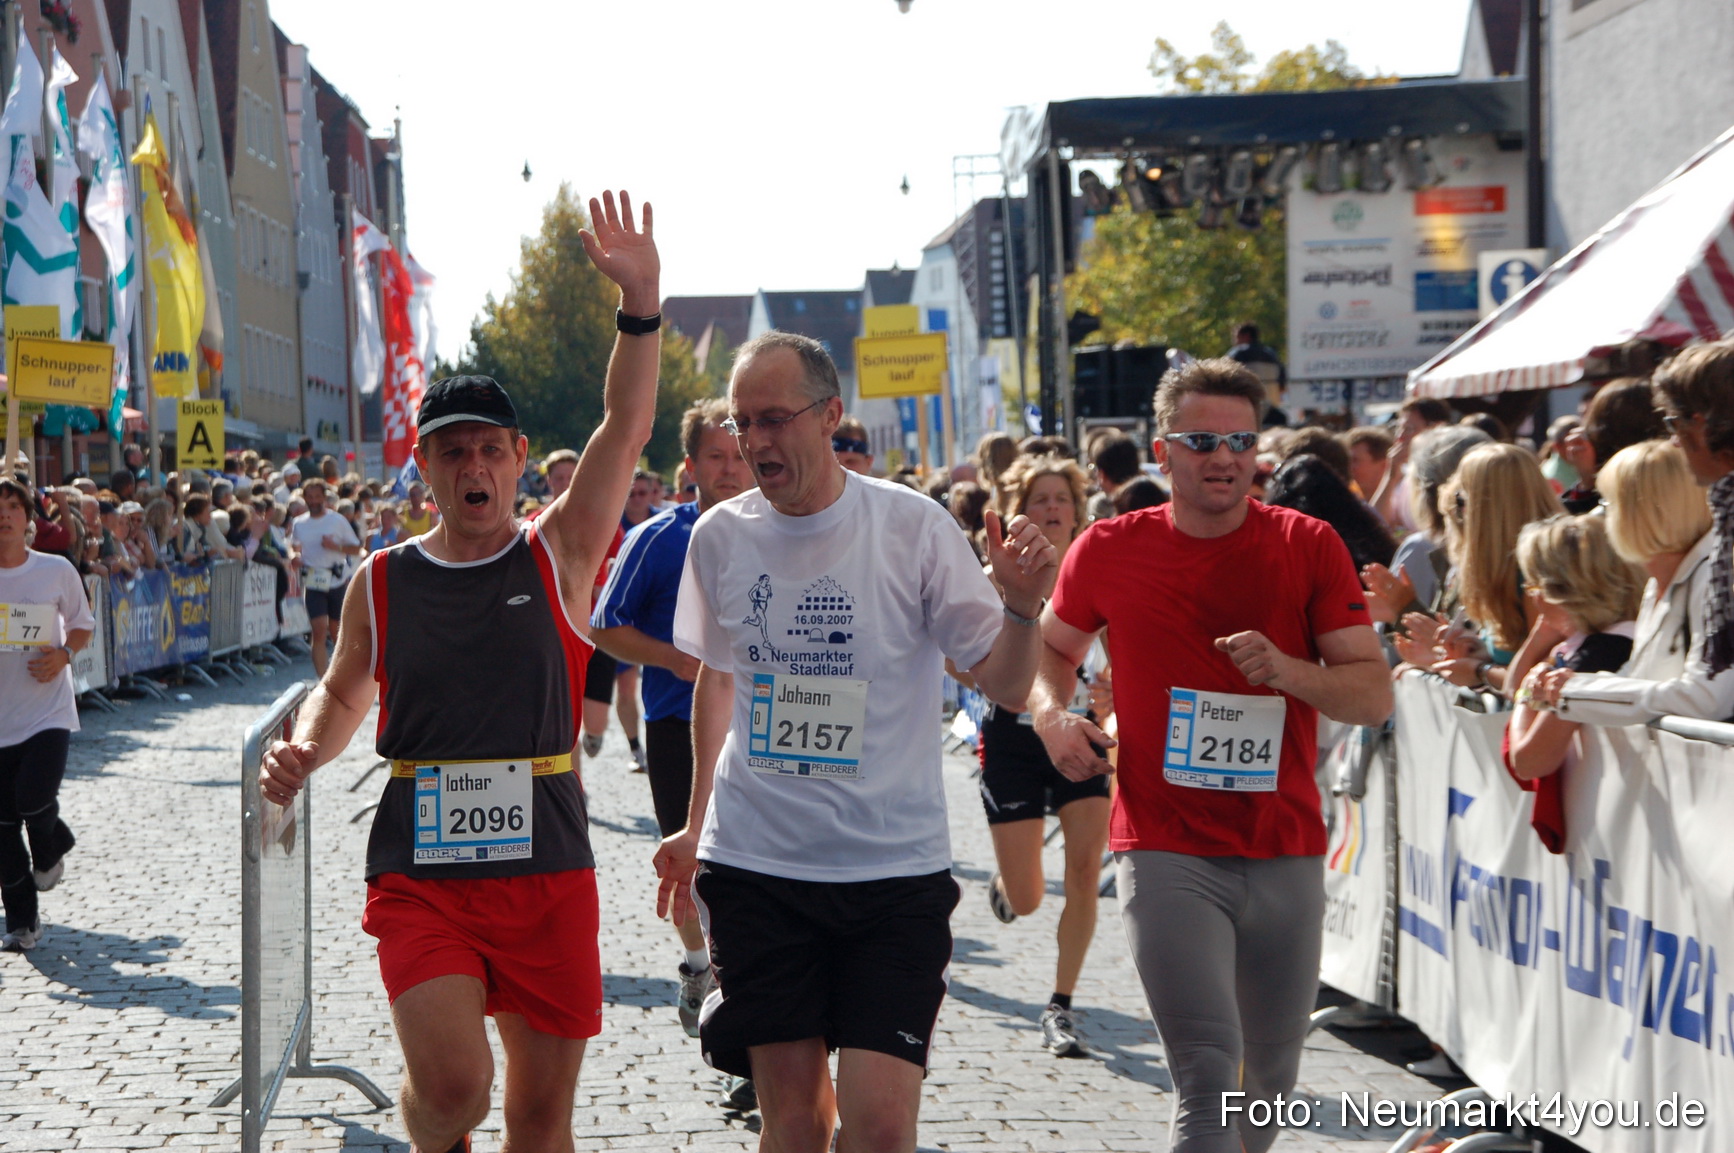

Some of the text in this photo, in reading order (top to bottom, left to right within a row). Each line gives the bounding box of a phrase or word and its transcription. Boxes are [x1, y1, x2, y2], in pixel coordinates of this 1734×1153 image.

[21, 354, 107, 375] Schnupper-
[49, 374, 77, 388] lauf
[890, 369, 915, 381] lauf
[182, 401, 218, 415] Block
[188, 420, 213, 453] A
[11, 608, 27, 618] Jan
[794, 615, 854, 625] 16.09.2007
[22, 625, 41, 639] 77
[748, 645, 853, 663] 8. Neumarkter
[789, 663, 854, 676] Stadtlauf
[777, 684, 831, 706] Johann
[754, 711, 760, 725] D
[1200, 700, 1244, 722] Peter
[776, 720, 853, 752] 2157
[1172, 726, 1180, 739] C
[1199, 736, 1272, 764] 2184
[748, 757, 784, 770] BOCK
[811, 763, 858, 774] PFLEIDERER
[1165, 770, 1208, 783] BOCK
[1236, 776, 1276, 786] PFLEIDERER
[420, 804, 427, 818] D
[449, 805, 524, 835] 2096
[416, 848, 460, 859] BOCK
[489, 843, 530, 855] PFLEIDERER
